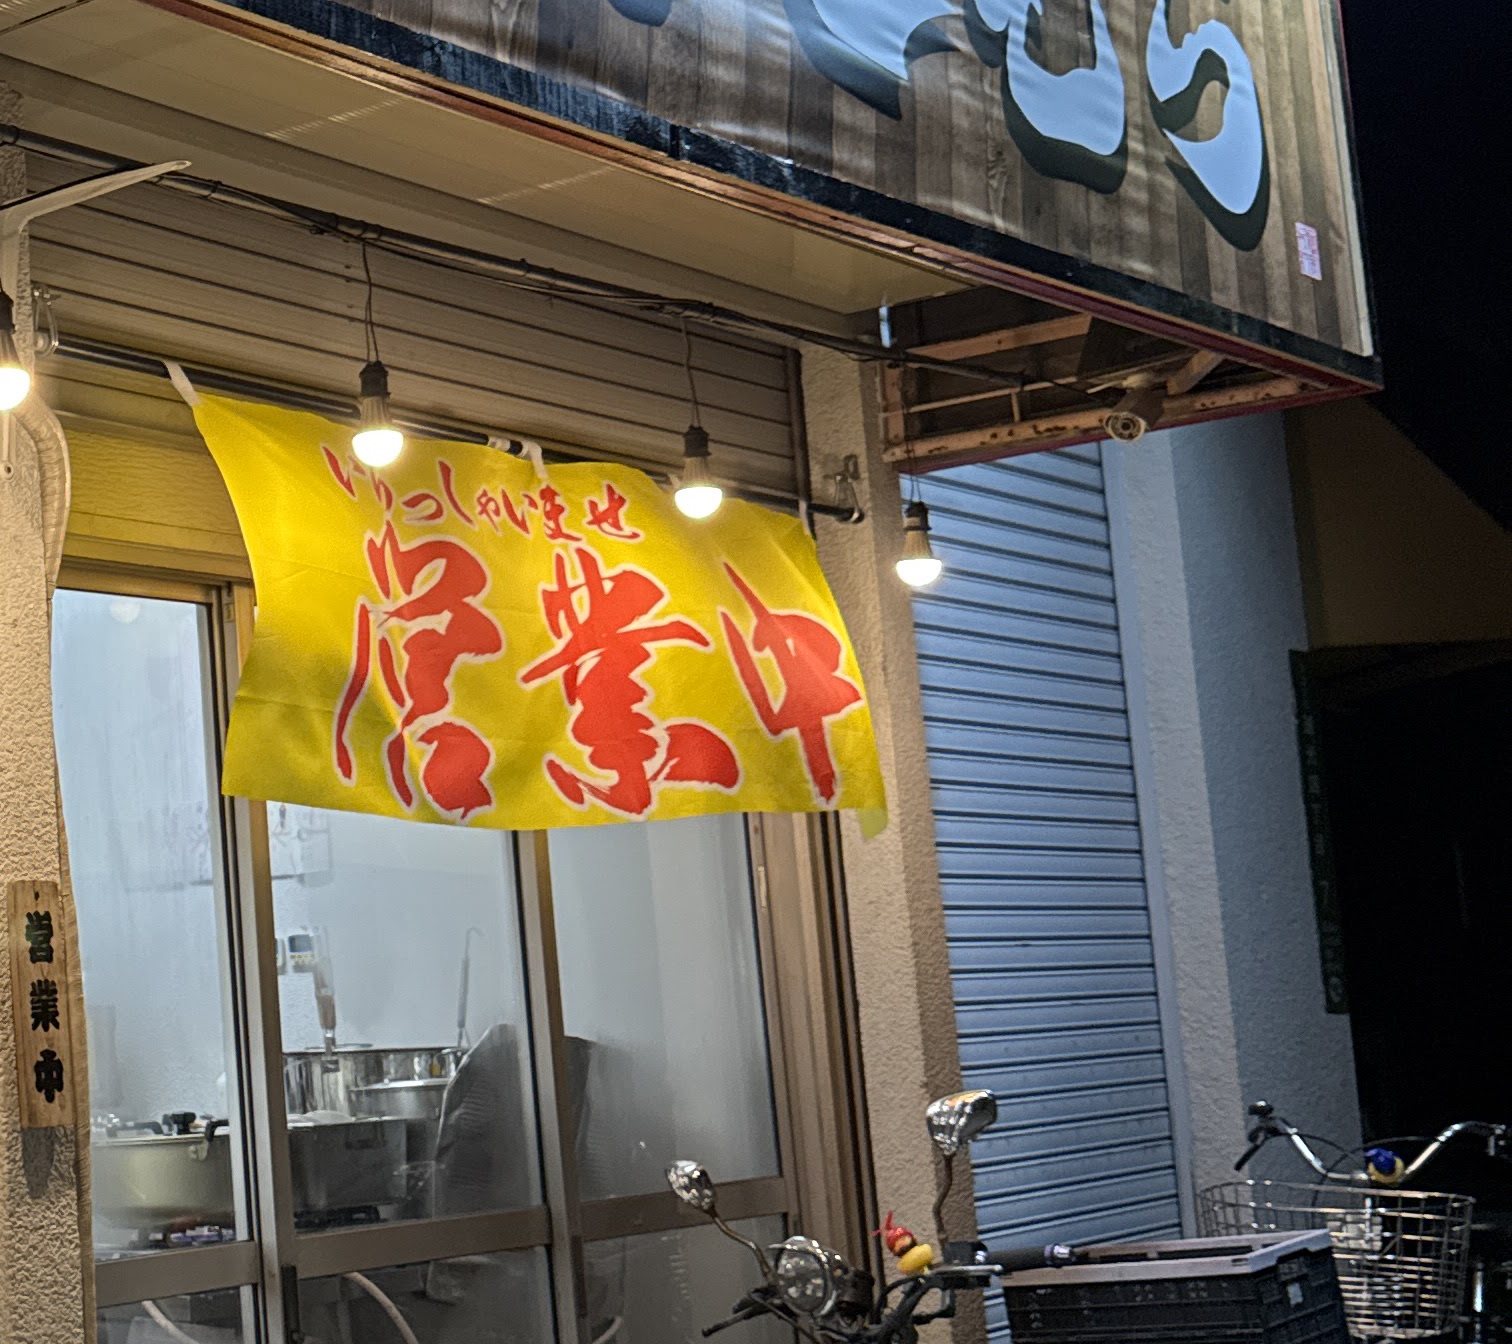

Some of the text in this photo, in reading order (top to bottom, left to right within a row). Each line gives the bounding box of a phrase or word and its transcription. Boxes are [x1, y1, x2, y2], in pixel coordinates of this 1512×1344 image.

[321, 445, 642, 544] いらっしゃいませ
[334, 521, 863, 820] 営業中
[25, 910, 65, 1104] 営業中
